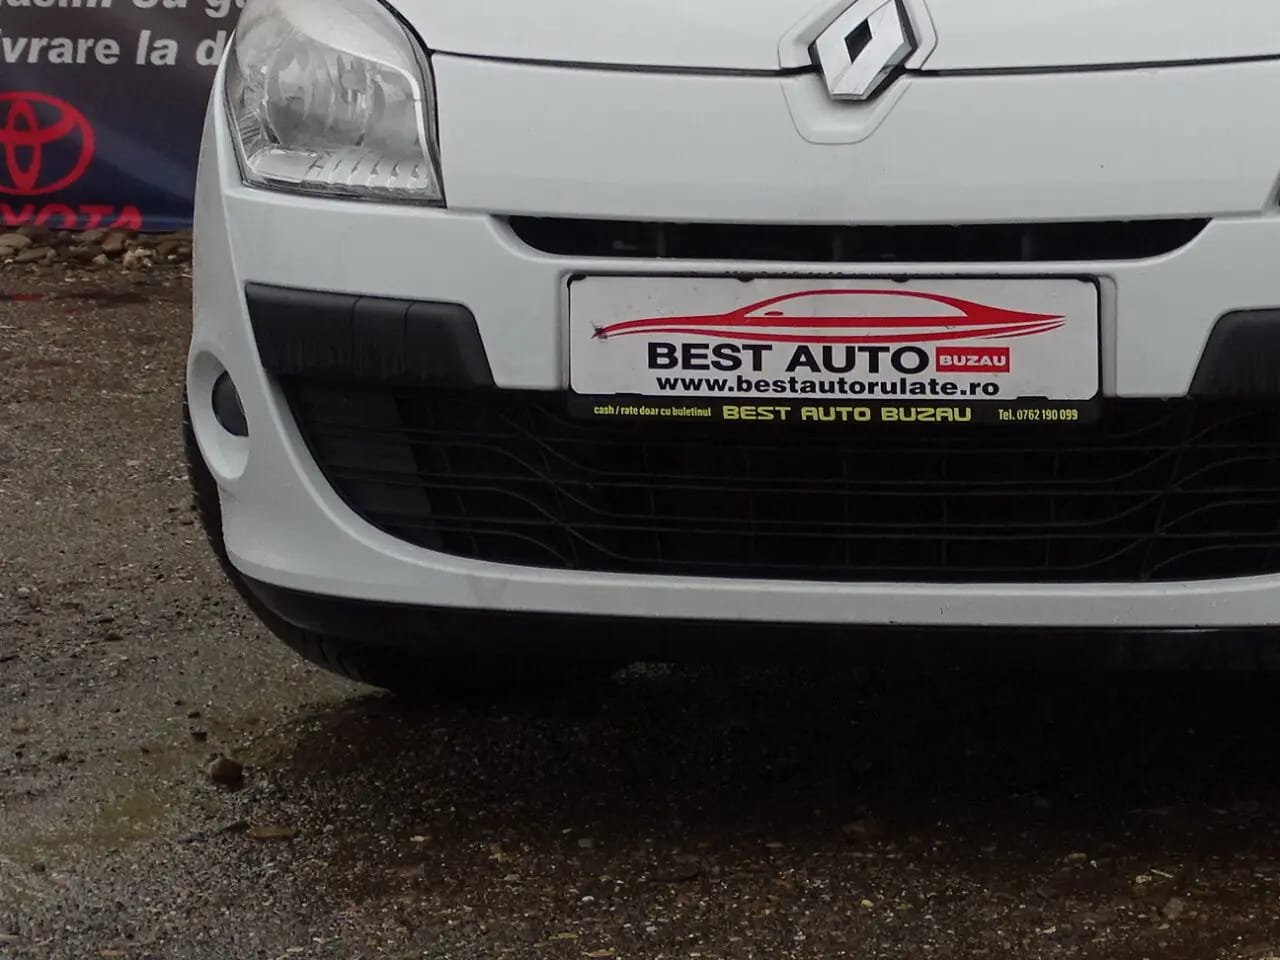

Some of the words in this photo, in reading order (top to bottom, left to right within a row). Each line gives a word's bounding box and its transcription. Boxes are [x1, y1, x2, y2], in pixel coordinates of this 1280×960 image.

[0, 28, 120, 65] vrare
[136, 30, 178, 66] la
[647, 341, 773, 372] BEST
[785, 344, 930, 375] AUTO
[938, 353, 1007, 368] BUZAU
[655, 374, 1001, 396] www.bestautorulate.ro
[593, 405, 614, 415] cash
[620, 406, 639, 416] rate
[639, 406, 659, 416] doar
[660, 408, 671, 416] cu
[722, 405, 791, 420] BEST
[801, 405, 871, 421] AUTO
[881, 407, 972, 422] BUZAU
[998, 408, 1016, 420] Tel.
[1016, 409, 1040, 421] 0762
[1041, 409, 1058, 421] 190
[1059, 409, 1079, 421] 099
